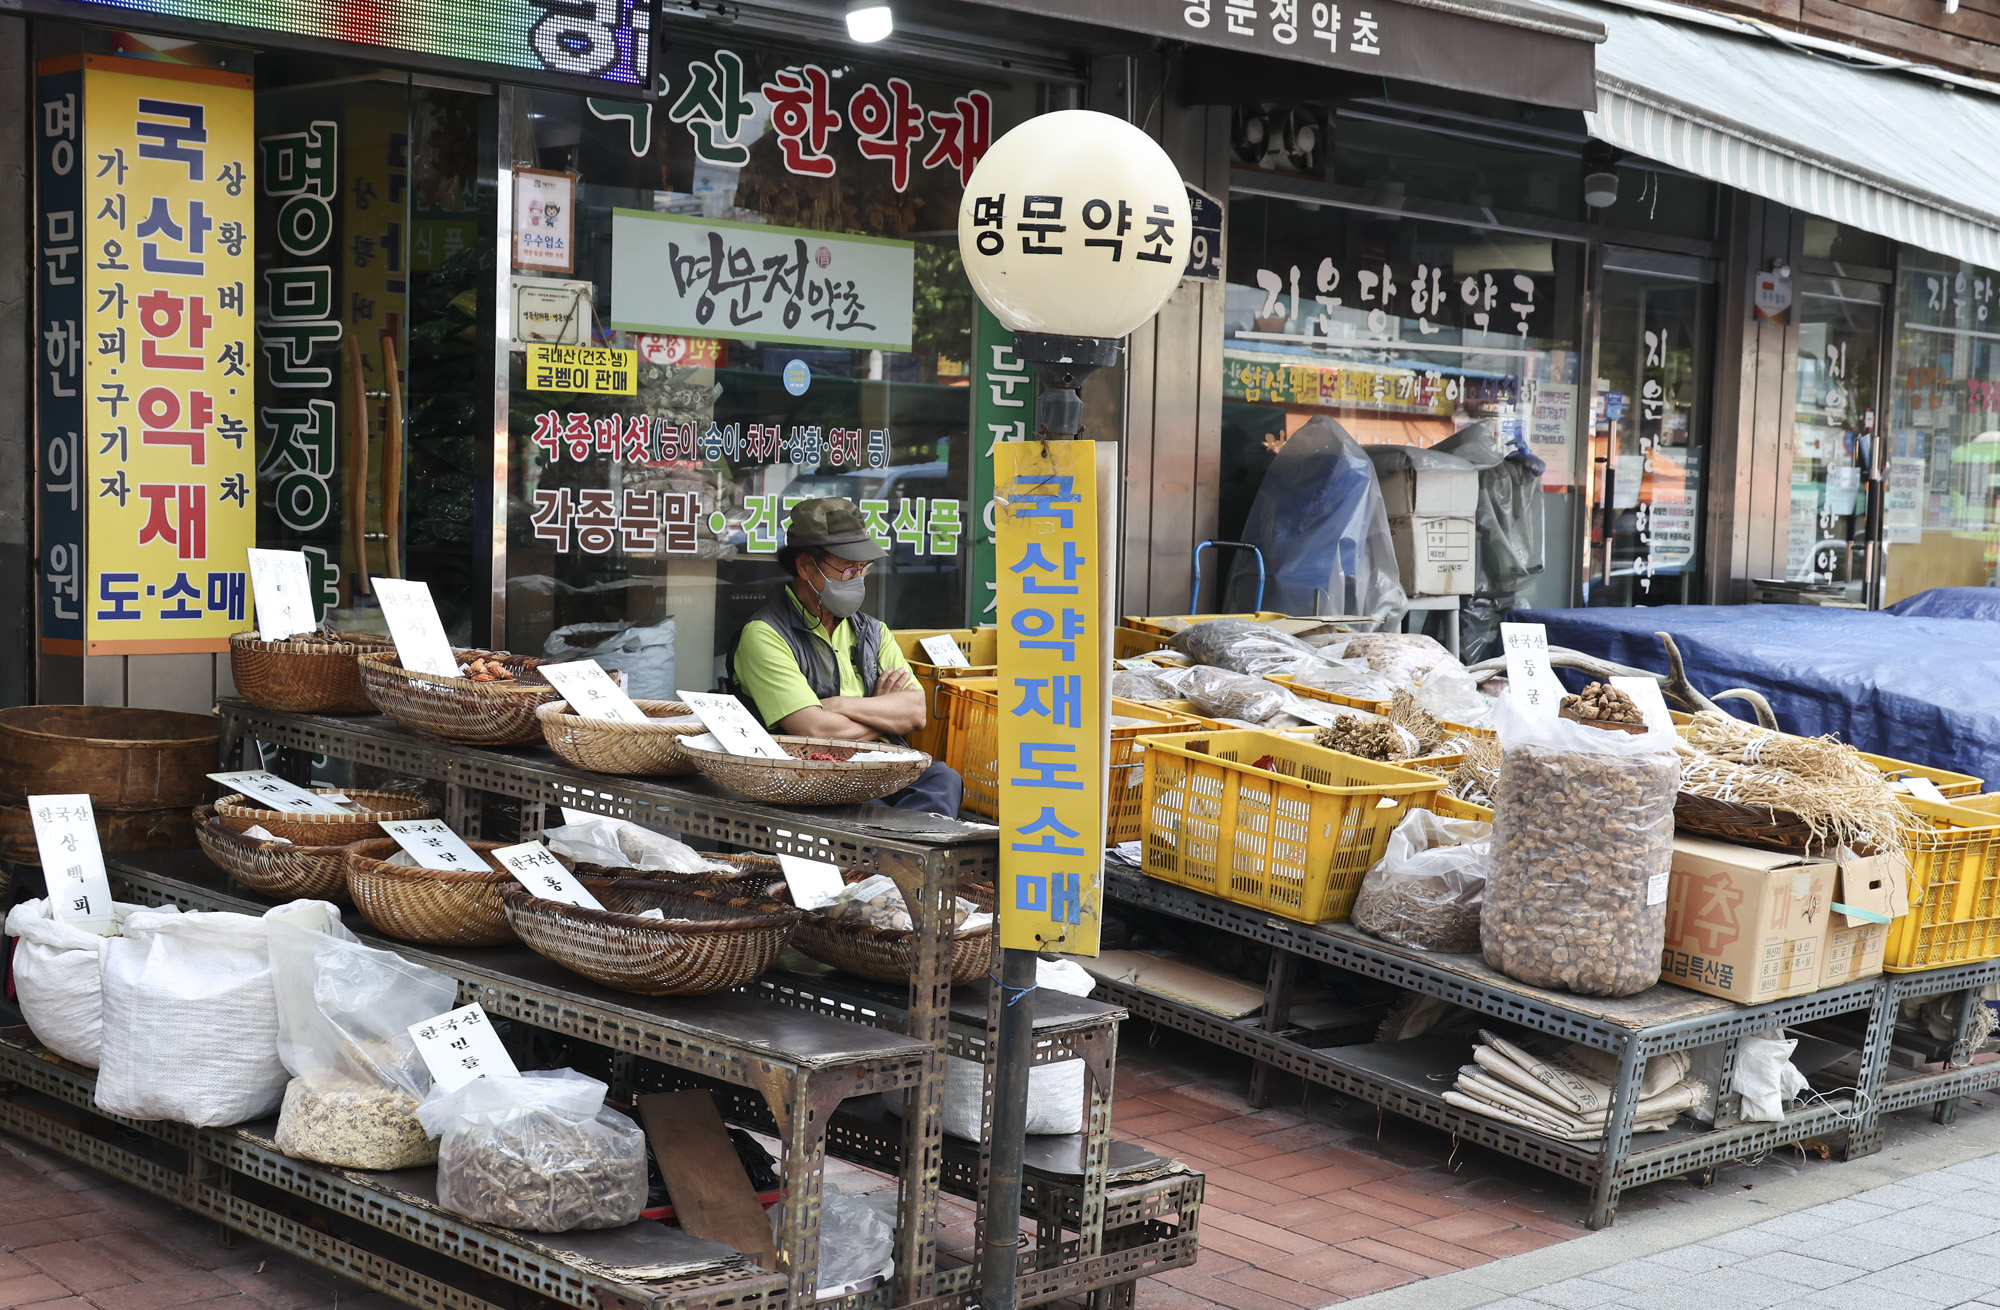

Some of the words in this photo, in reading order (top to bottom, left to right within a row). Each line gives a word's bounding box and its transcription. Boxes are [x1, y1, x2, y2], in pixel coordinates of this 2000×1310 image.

[524, 233, 564, 249] 우수업소
[973, 193, 1175, 264] 명문약초
[668, 231, 876, 330] 명문정약초
[1256, 257, 1535, 340] 지운당한약국
[1926, 271, 2000, 321] 지운당
[136, 97, 213, 560] 국산한약재
[43, 93, 80, 620] 명문한의원
[536, 366, 589, 389] 굼벵이
[595, 369, 628, 391] 판매
[867, 428, 891, 469] 등)
[97, 572, 246, 620] 도·소매
[1507, 634, 1545, 649] 한국산
[553, 668, 604, 684] 한국산
[693, 698, 742, 711] 한국산
[1010, 474, 1086, 925] 국산약재도소매
[37, 805, 89, 823] 한국산
[392, 823, 448, 836] 한국산
[61, 833, 91, 915] 상백피
[508, 851, 555, 870] 한국산
[1661, 948, 1734, 990] 고급특산품
[418, 1011, 482, 1040] 한국산
